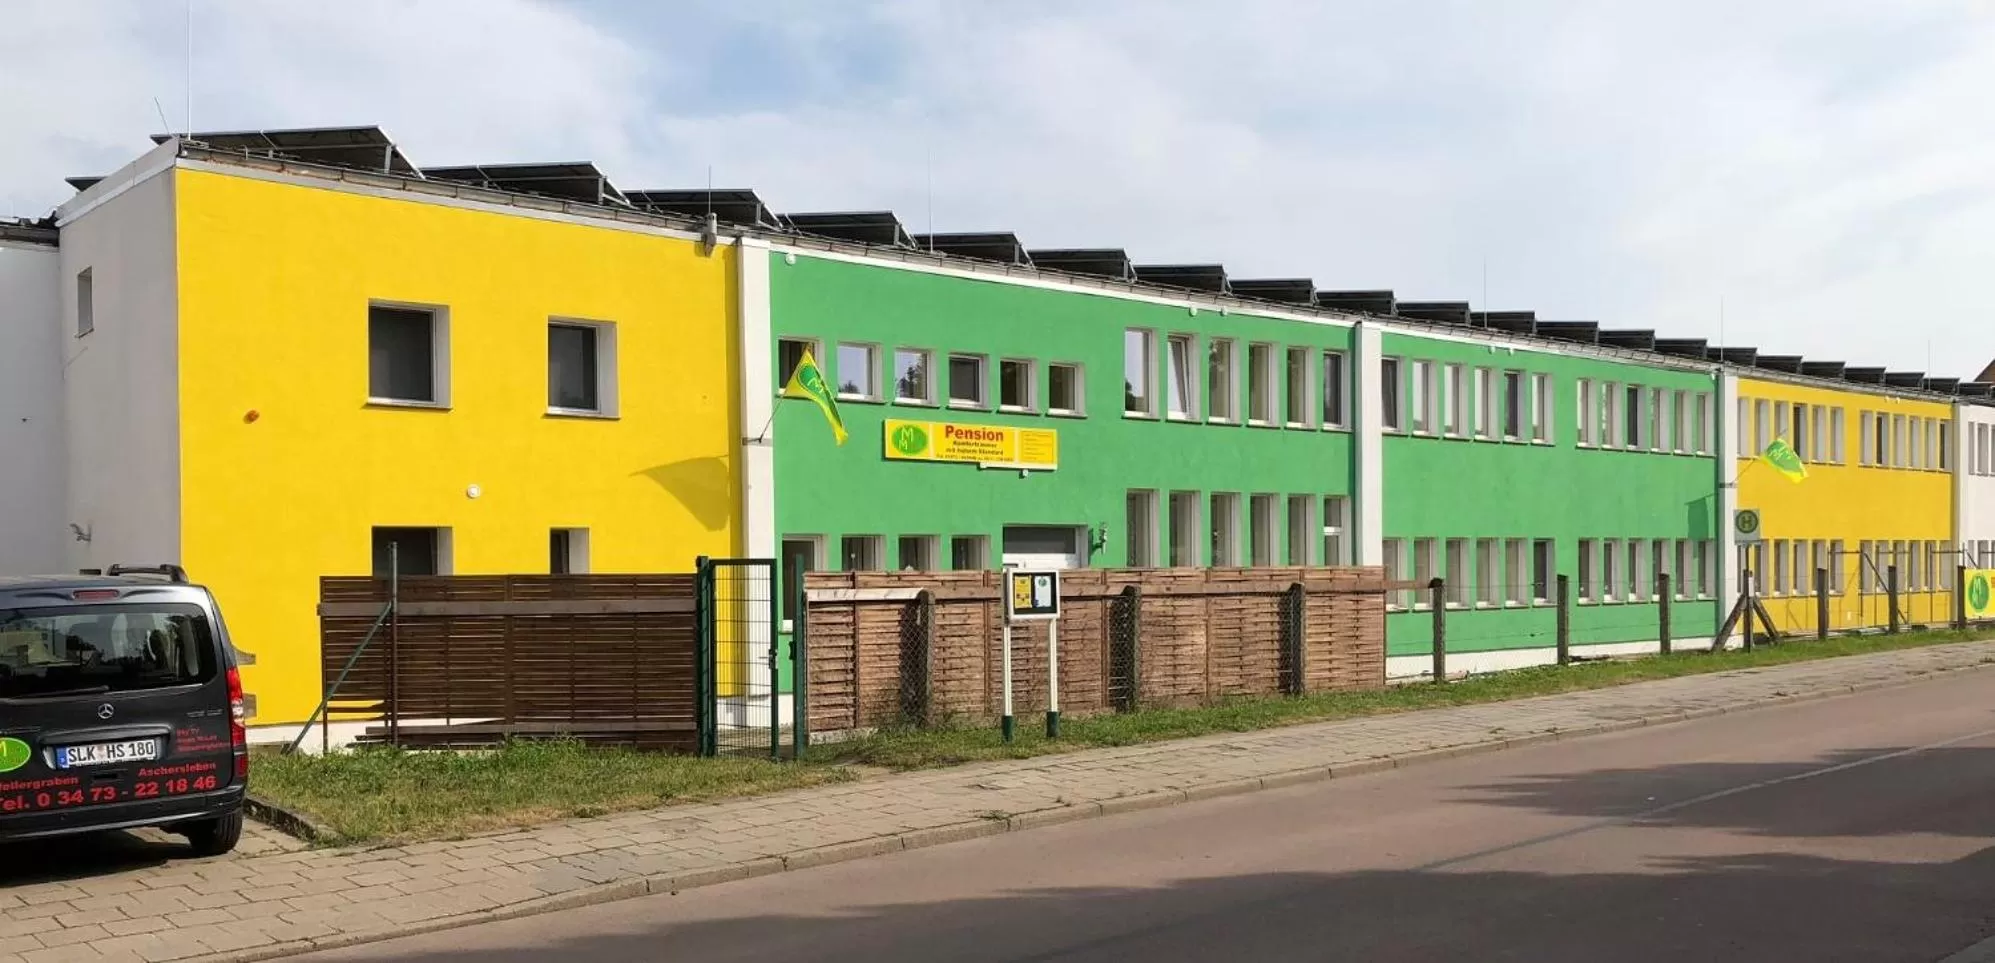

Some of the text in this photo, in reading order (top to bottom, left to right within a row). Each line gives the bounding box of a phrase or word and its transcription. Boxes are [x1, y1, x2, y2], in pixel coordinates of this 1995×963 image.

[945, 425, 1004, 442] Pension
[1741, 515, 1753, 529] H
[68, 741, 154, 762] SLK HS 180
[138, 763, 216, 777] Aschersleben
[37, 793, 50, 807] 0
[57, 789, 84, 805] 34
[90, 786, 116, 802] 73
[135, 782, 159, 798] 22
[165, 779, 189, 793] 18
[193, 776, 216, 790] 46
